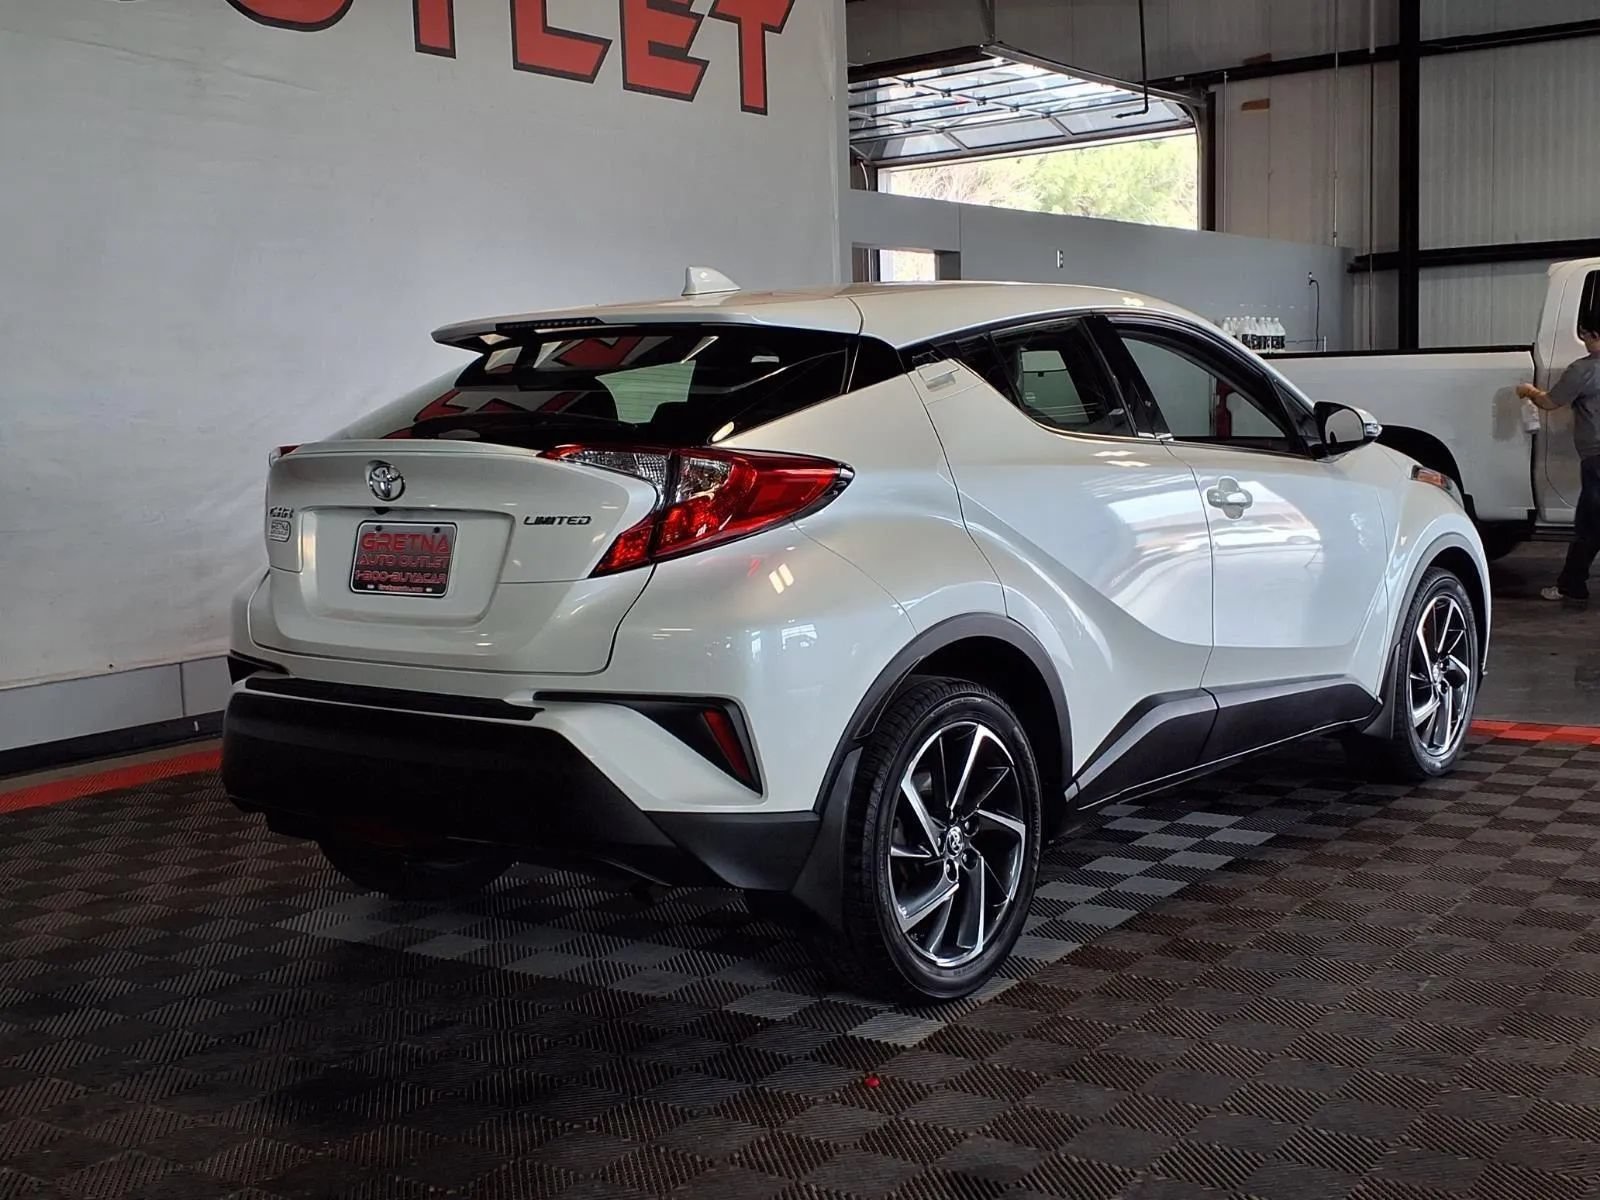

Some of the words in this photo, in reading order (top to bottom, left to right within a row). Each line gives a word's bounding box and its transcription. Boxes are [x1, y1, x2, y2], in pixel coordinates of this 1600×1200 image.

[227, 0, 796, 116] LET
[523, 515, 593, 526] LIMITED
[361, 531, 450, 553] GRETNA
[358, 553, 396, 567] AUTO
[399, 554, 452, 569] OUTLET
